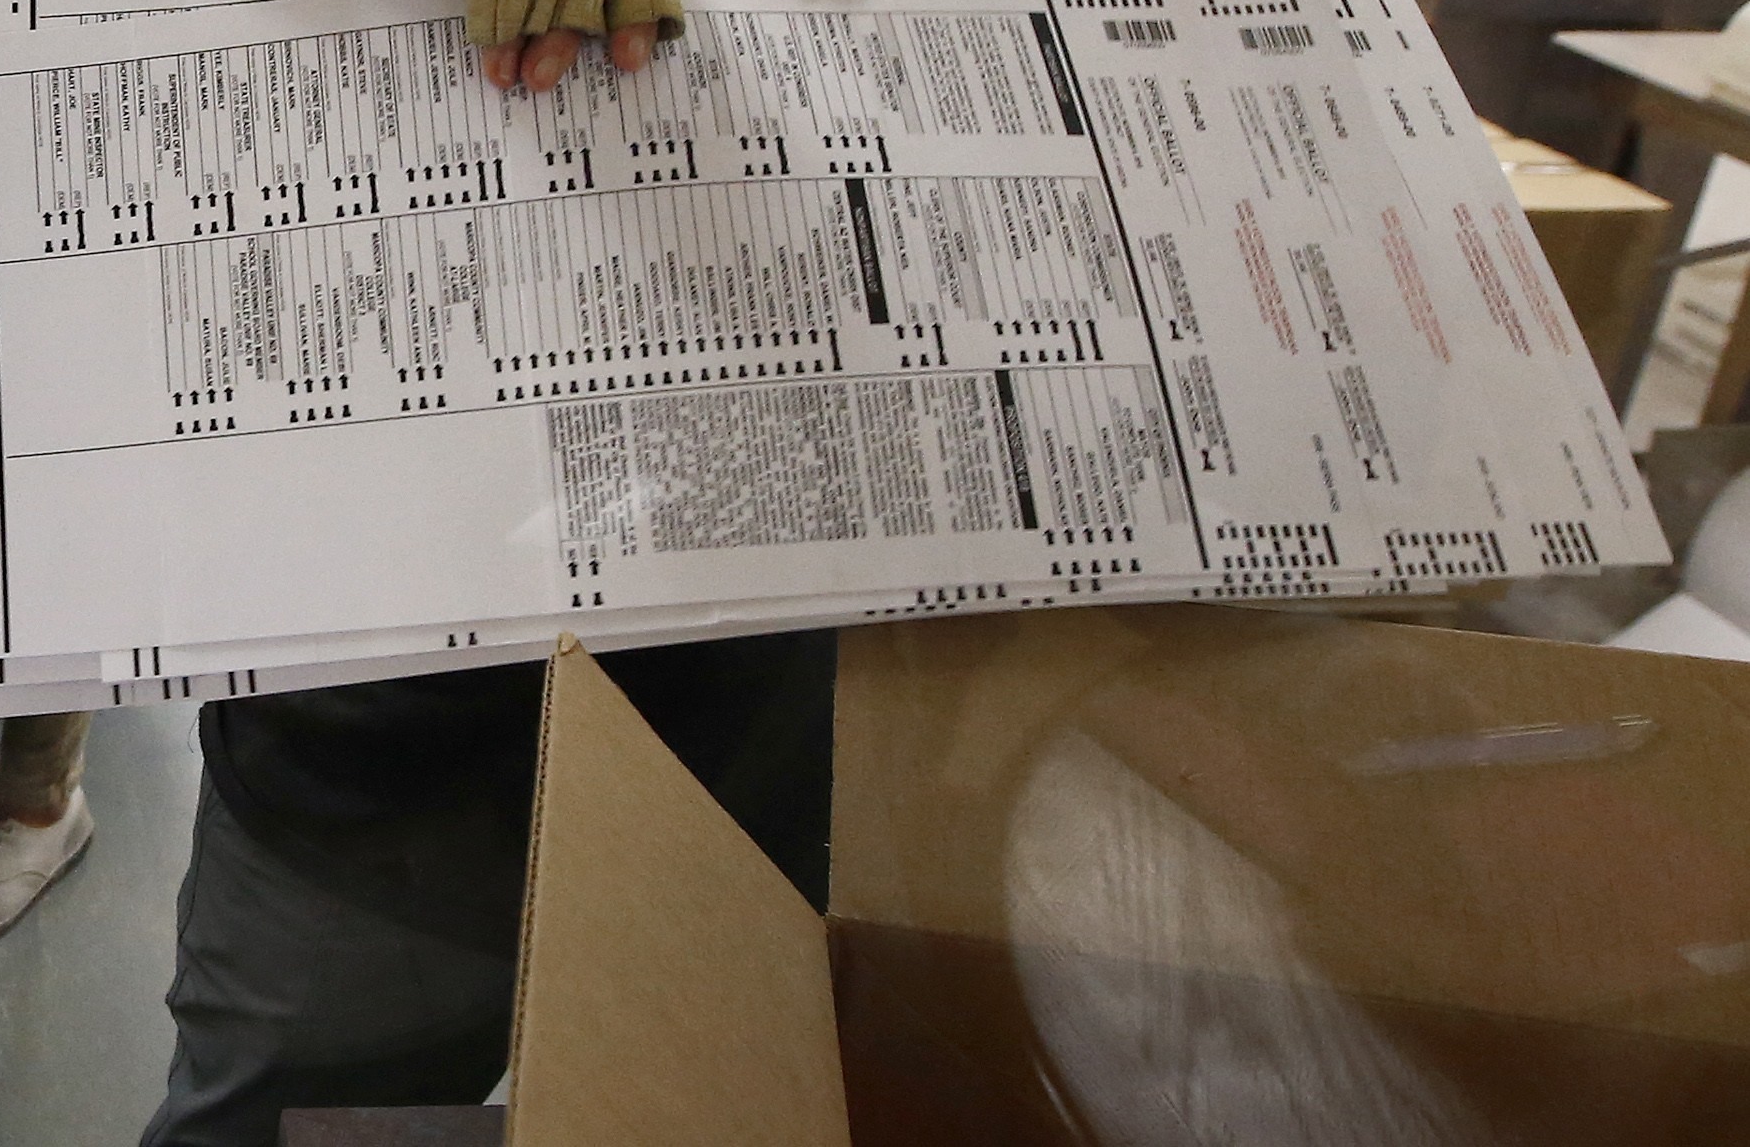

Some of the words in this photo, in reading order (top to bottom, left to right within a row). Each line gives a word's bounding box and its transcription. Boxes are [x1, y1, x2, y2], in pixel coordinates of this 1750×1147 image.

[50, 70, 59, 101] PIERCE,
[66, 68, 75, 92] HART,
[119, 62, 129, 104] HOFFMAN,
[239, 82, 248, 105] STATE
[308, 69, 319, 108] ATTORNEY
[380, 57, 392, 101] SECRETARY
[67, 93, 76, 110] JOE
[91, 92, 100, 115] STATE
[136, 88, 146, 116] FRANK
[152, 102, 160, 115] FOR
[168, 73, 179, 138] SUPERINTENDENT
[199, 86, 208, 110] MARK
[231, 93, 240, 106] FOR
[232, 106, 241, 119] NOT
[52, 102, 61, 136] WILLIAM
[84, 111, 92, 124] FOR
[92, 116, 101, 135] MINE
[121, 104, 130, 132] KATHY
[153, 116, 161, 129] NOT
[160, 102, 171, 151] INSTRUCTION
[233, 119, 242, 138] MORE
[241, 106, 252, 151] TREASURER
[270, 95, 280, 133] JANUARY
[312, 108, 323, 144] GENERAL
[385, 114, 395, 138] STATE
[1142, 74, 1171, 130] OFFICIAL
[1160, 127, 1186, 176] BALLOT
[84, 124, 92, 137] NOT
[154, 129, 162, 147] MORE
[85, 137, 93, 156] MORE
[93, 135, 104, 178] INSPECTOR
[155, 147, 163, 164] THAN
[235, 138, 243, 155] THAN
[86, 156, 94, 173] THAN
[172, 150, 182, 178] PUBLIC
[247, 237, 256, 269] SCHOOL
[262, 248, 272, 287] PARADISE
[238, 251, 248, 290] PARADISE
[458, 265, 470, 301] COLLEGE
[249, 269, 259, 316] GOVERNING
[264, 288, 274, 318] VALLEY
[355, 274, 365, 310] DISTRICT
[364, 275, 375, 312] COLLEGE
[373, 273, 384, 306] COUNTY
[240, 291, 250, 321] VALLEY
[251, 316, 261, 345] BOARD
[253, 345, 263, 380] MEMBER
